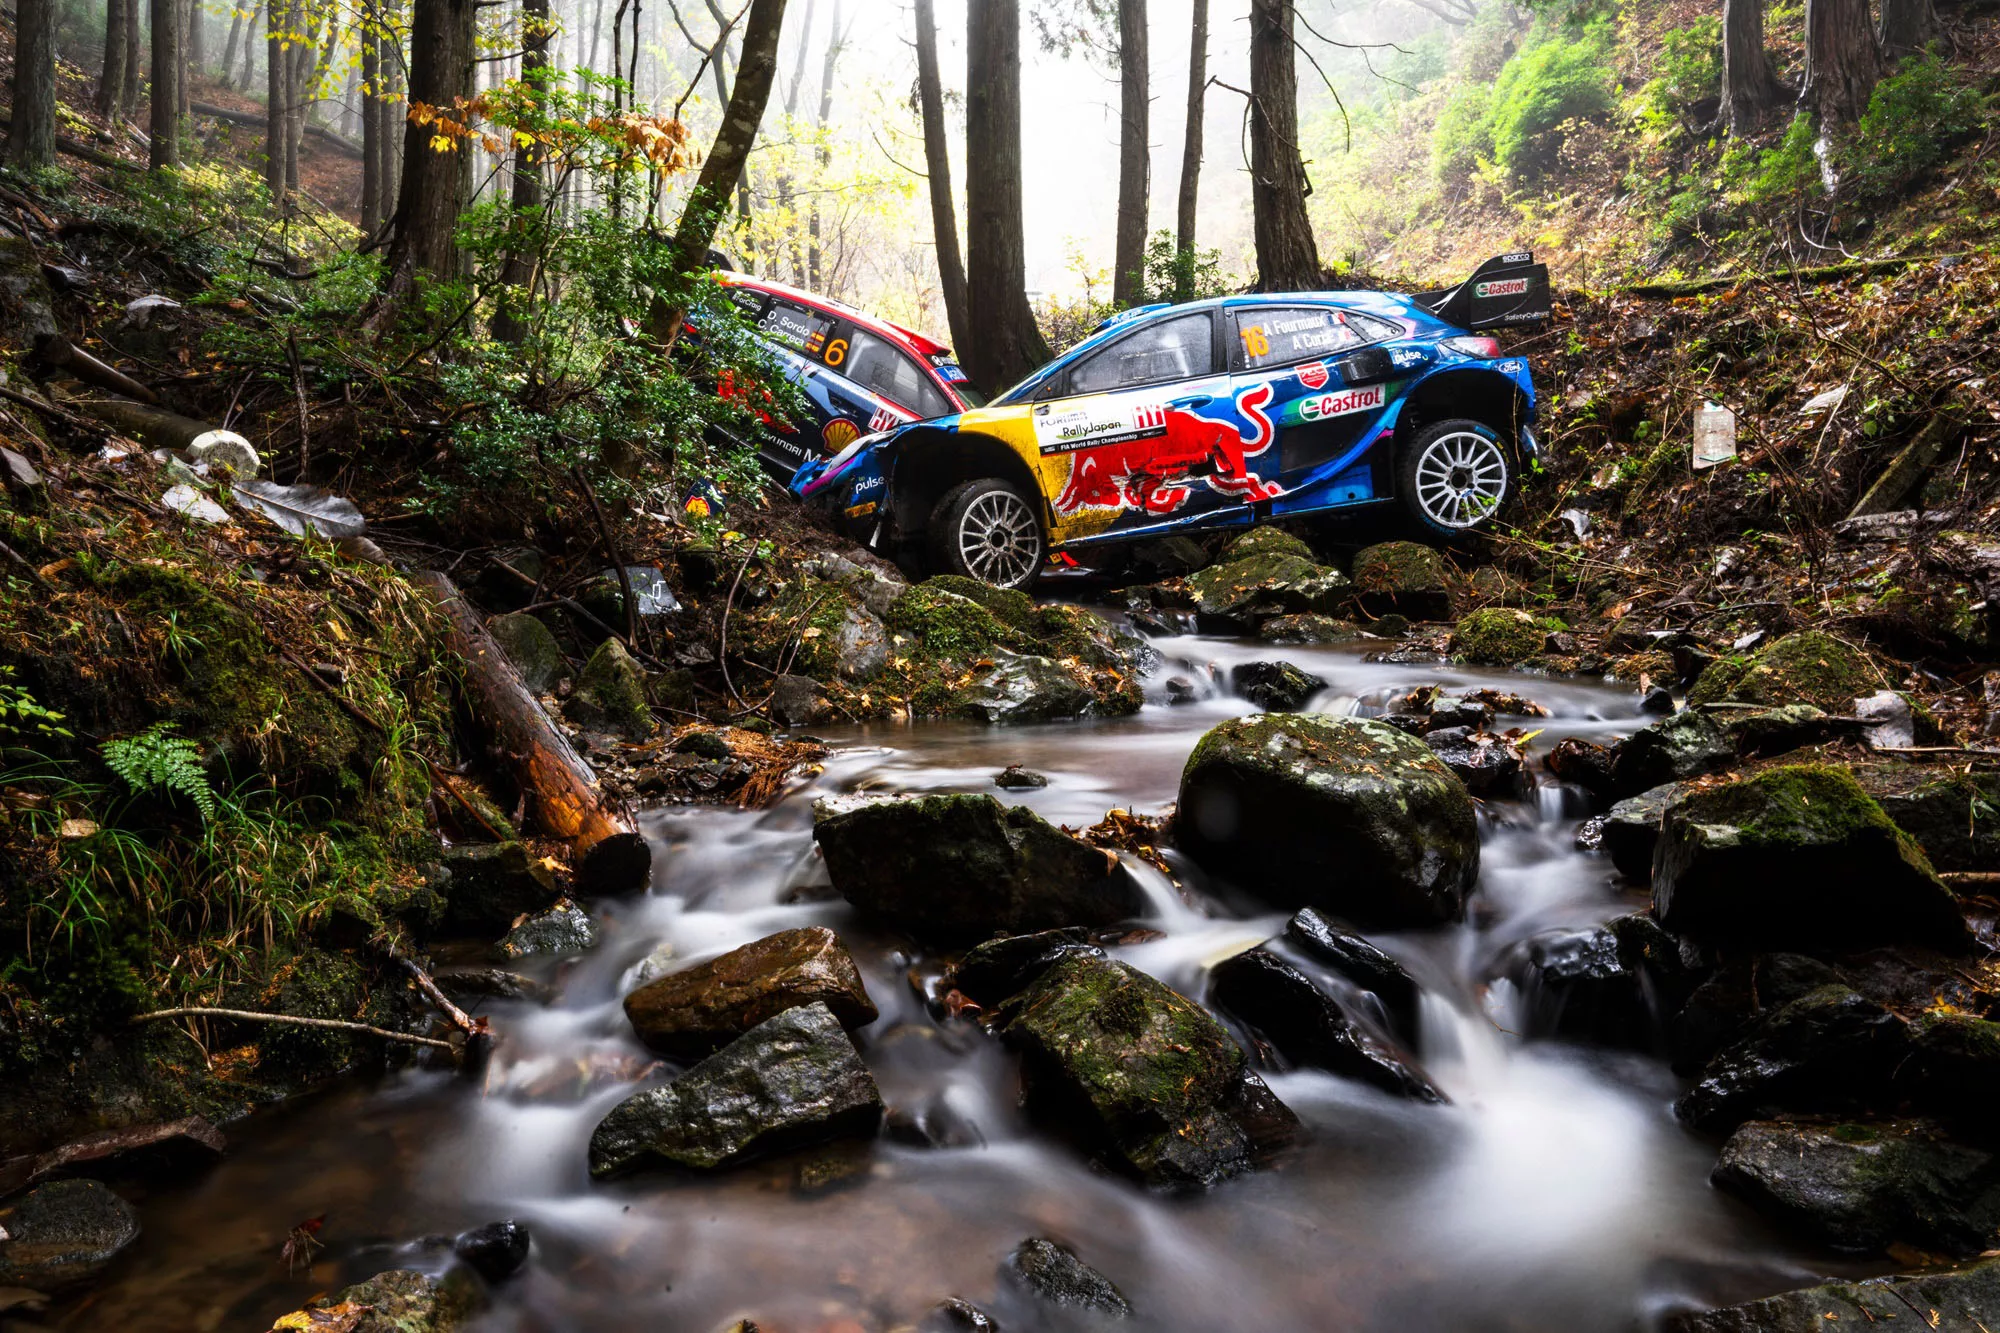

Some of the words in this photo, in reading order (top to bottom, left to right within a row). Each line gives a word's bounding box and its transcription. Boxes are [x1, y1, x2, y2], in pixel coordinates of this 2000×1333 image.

[1488, 280, 1525, 295] Castrol
[757, 319, 767, 330] C.
[770, 324, 805, 346] Carrera
[767, 310, 777, 322] D.
[780, 316, 810, 337] Sordo
[1262, 322, 1273, 337] A
[1274, 316, 1325, 334] Fourmaux
[824, 338, 849, 367] 6
[1240, 325, 1270, 358] 16
[1292, 338, 1302, 350] A
[1321, 386, 1381, 416] Castrol
[1062, 420, 1122, 437] RallyJapan
[763, 432, 802, 456] YUNDAI
[1071, 441, 1086, 449] World
[1087, 439, 1101, 447] Rally
[1101, 433, 1138, 445] Championship
[855, 476, 885, 494] pulse
